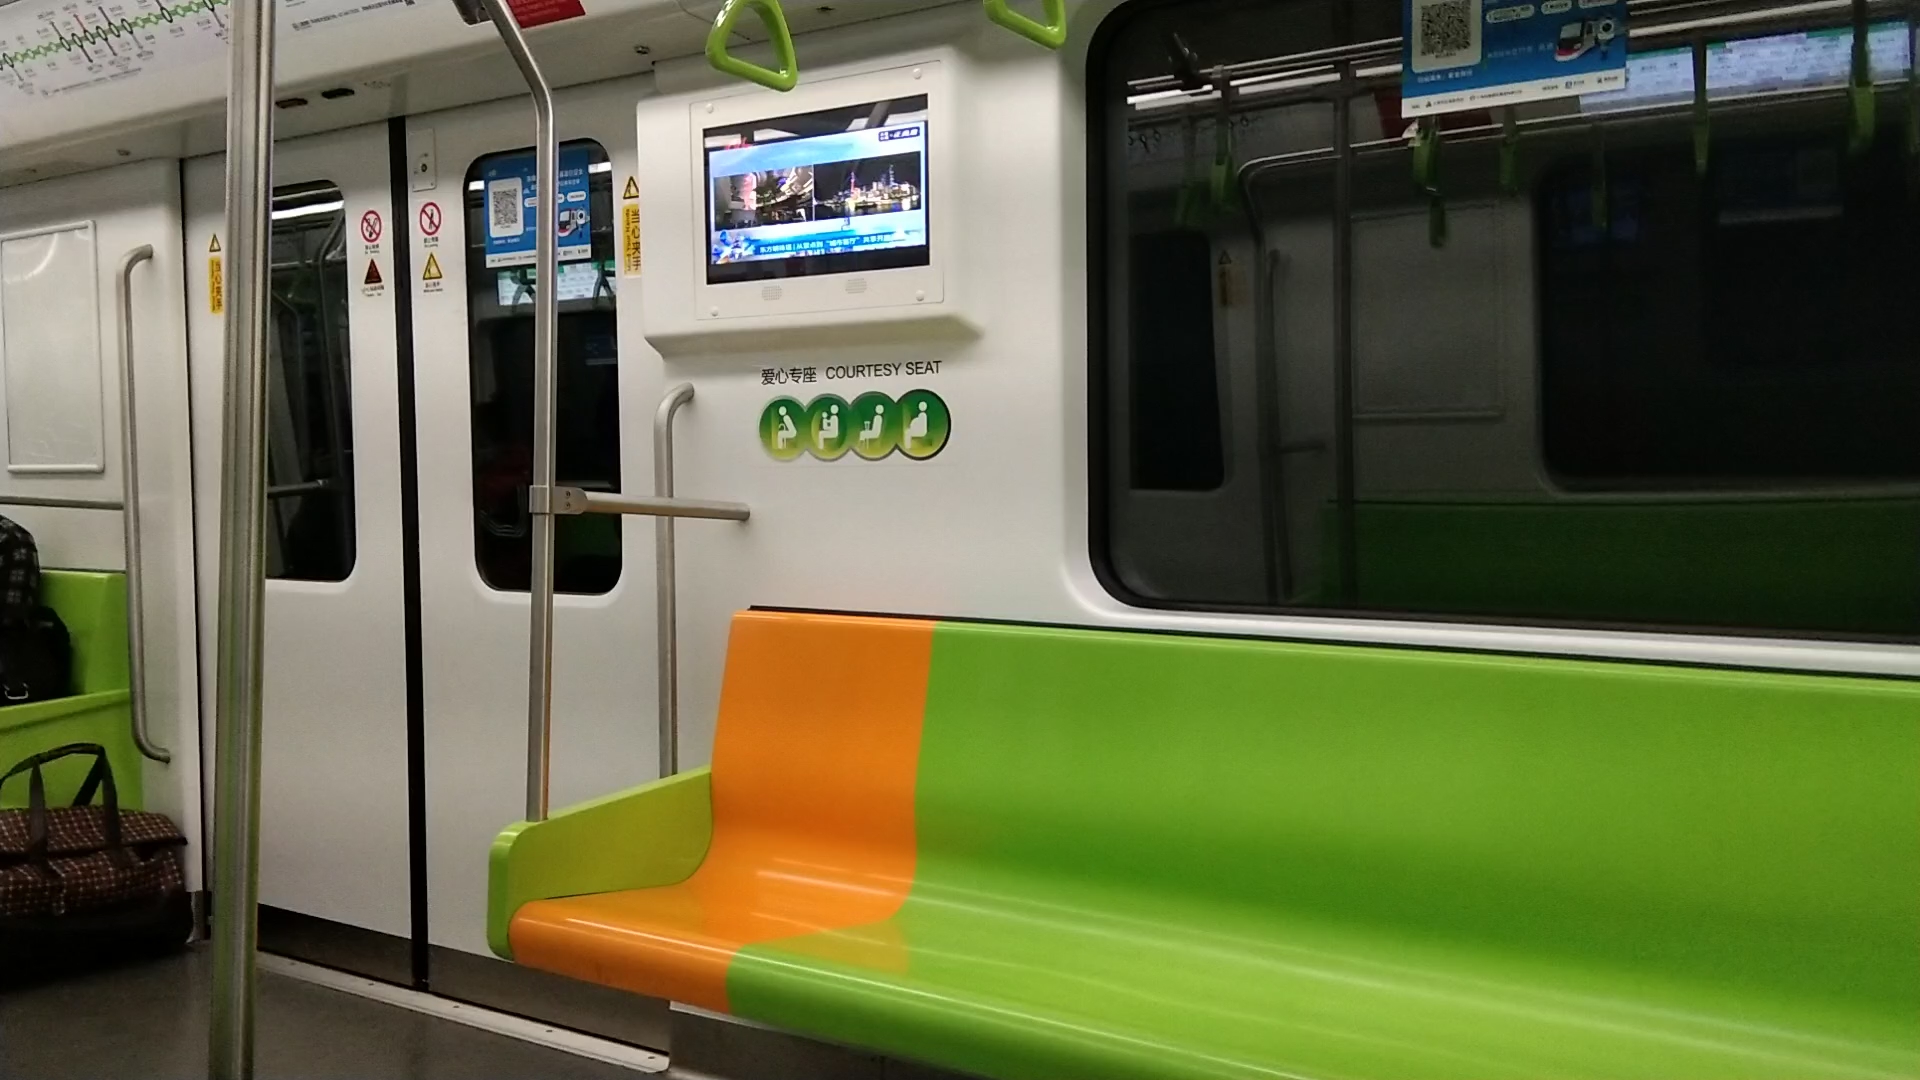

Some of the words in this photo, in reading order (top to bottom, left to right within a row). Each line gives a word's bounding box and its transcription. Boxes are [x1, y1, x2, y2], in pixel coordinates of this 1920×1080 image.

[762, 367, 817, 386] 爱心专座
[825, 362, 902, 380] COURTESY
[905, 361, 942, 376] SEAT
